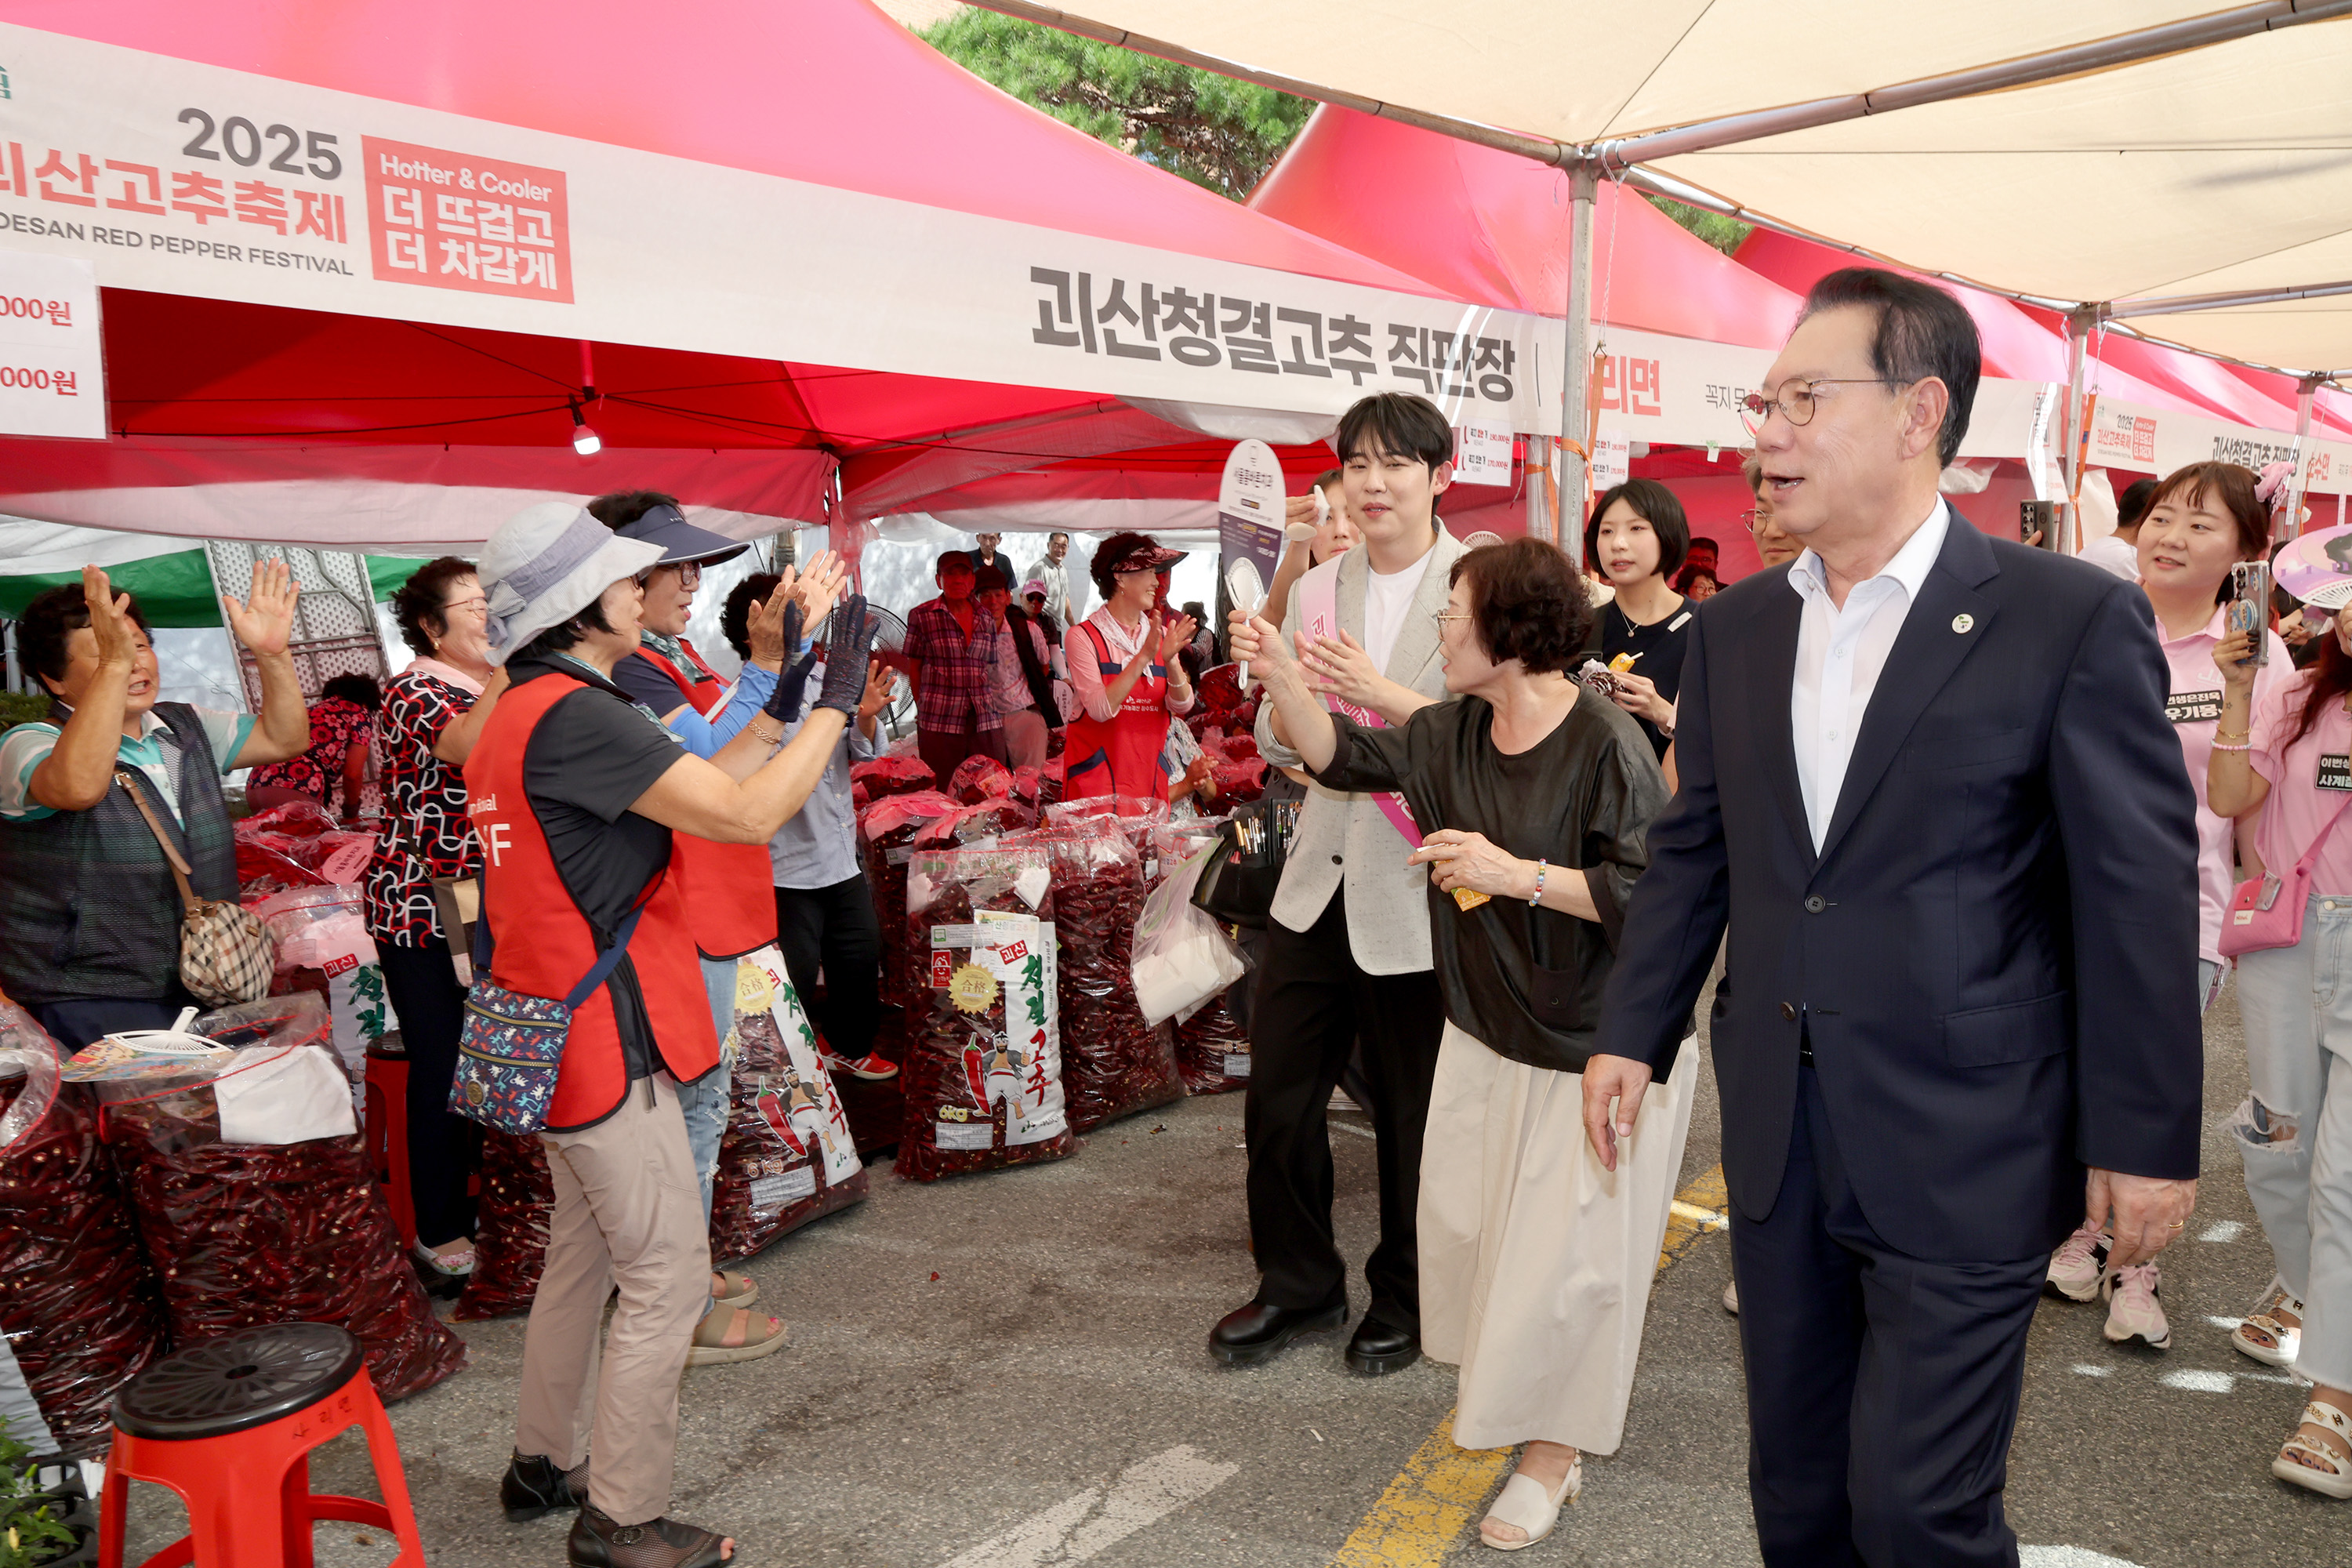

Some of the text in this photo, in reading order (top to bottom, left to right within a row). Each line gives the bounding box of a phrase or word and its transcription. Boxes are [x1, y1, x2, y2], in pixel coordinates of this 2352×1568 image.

[177, 108, 343, 180] 2025
[379, 153, 553, 202] Hotter & Cooler
[382, 184, 555, 248] 더 뜨겁고
[93, 226, 143, 248] RED
[151, 234, 243, 262] PEPPER
[249, 247, 354, 277] FESTIVAL
[386, 230, 558, 290] 더 차갑게
[1030, 266, 1377, 387] 괴산청결고추
[1387, 322, 1515, 402] 직판장
[1706, 384, 1731, 410] 꼭지
[2117, 414, 2133, 430] 2025
[1001, 941, 1025, 962] 괴산
[325, 956, 355, 975] 괴산
[740, 978, 764, 996] 合格
[960, 979, 986, 994] 合格
[1021, 953, 1052, 1107] 청결고추
[939, 1105, 968, 1123] 6kg
[747, 1159, 783, 1178] 6 kg
